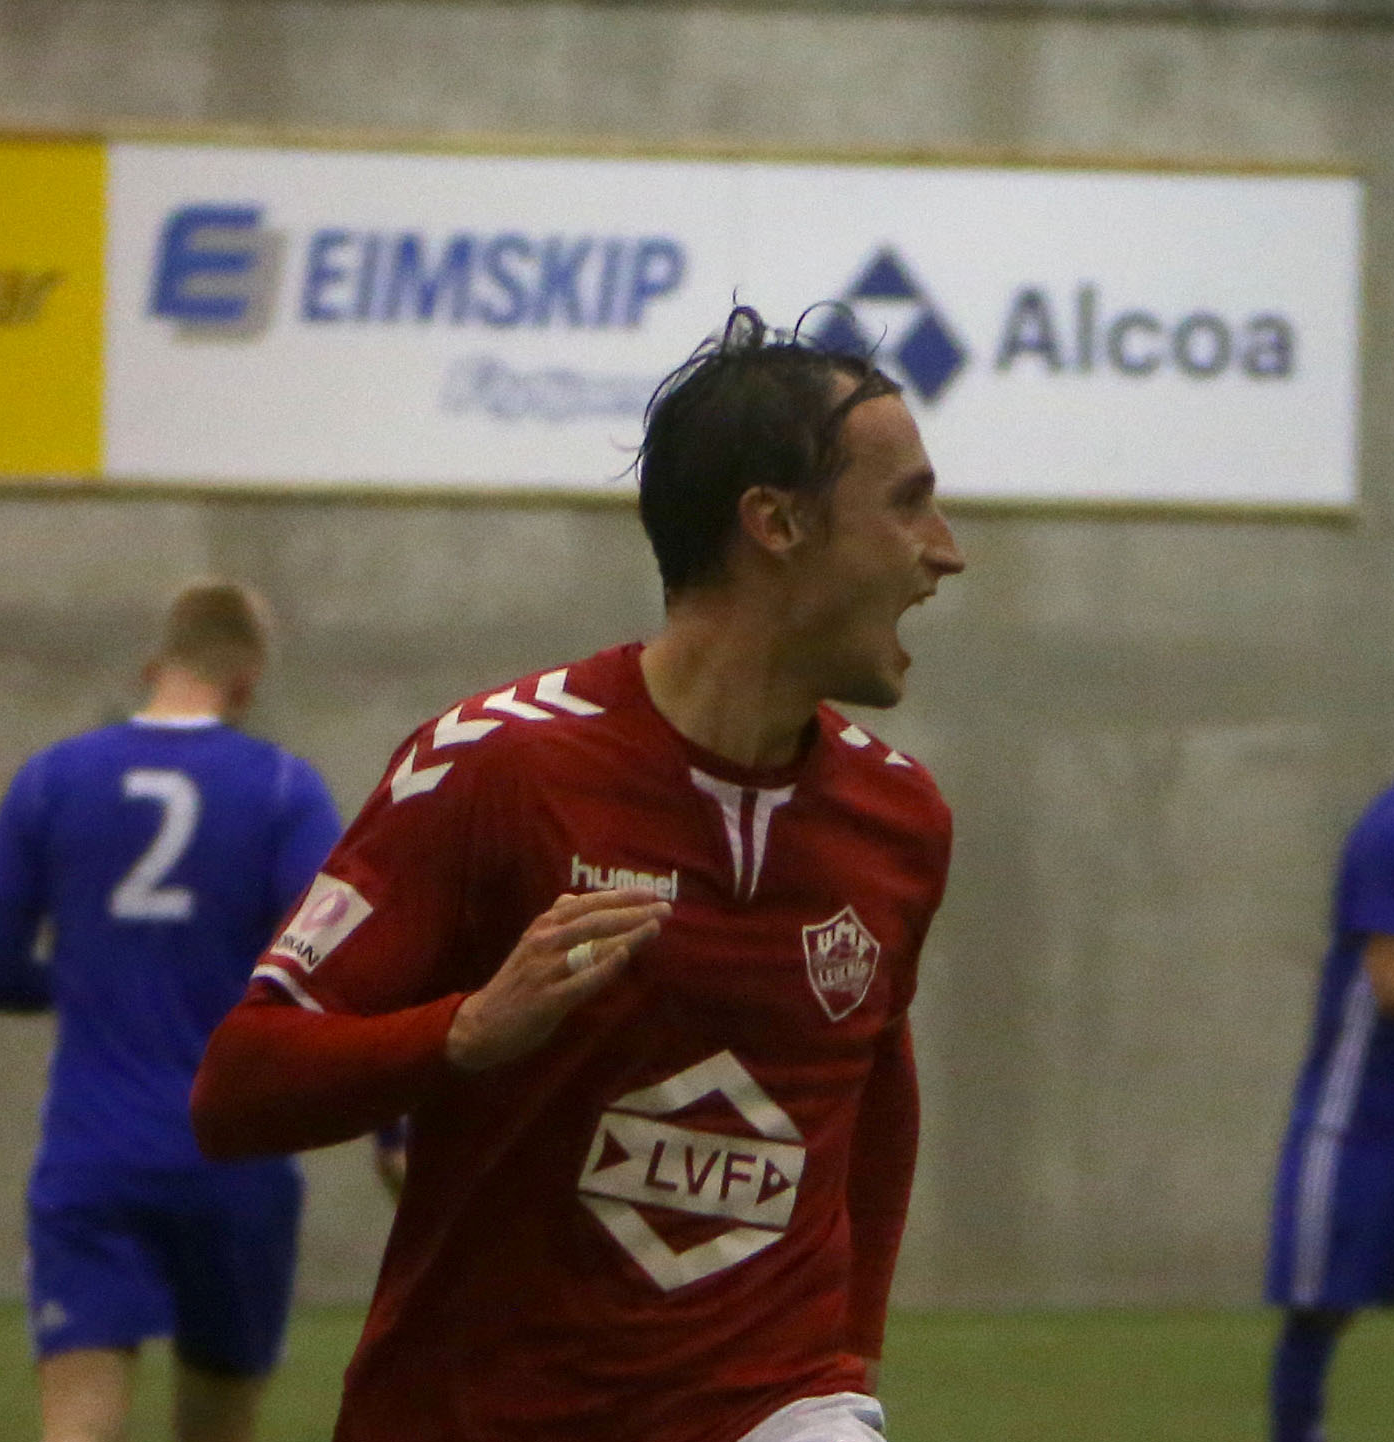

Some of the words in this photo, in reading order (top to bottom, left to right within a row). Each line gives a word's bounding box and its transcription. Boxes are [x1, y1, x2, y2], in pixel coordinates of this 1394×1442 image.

[303, 230, 687, 326] EIMSKIP
[995, 284, 1297, 382] Alcoa
[109, 768, 201, 922] 2
[569, 852, 679, 902] hummel
[645, 1139, 758, 1202] LVF
